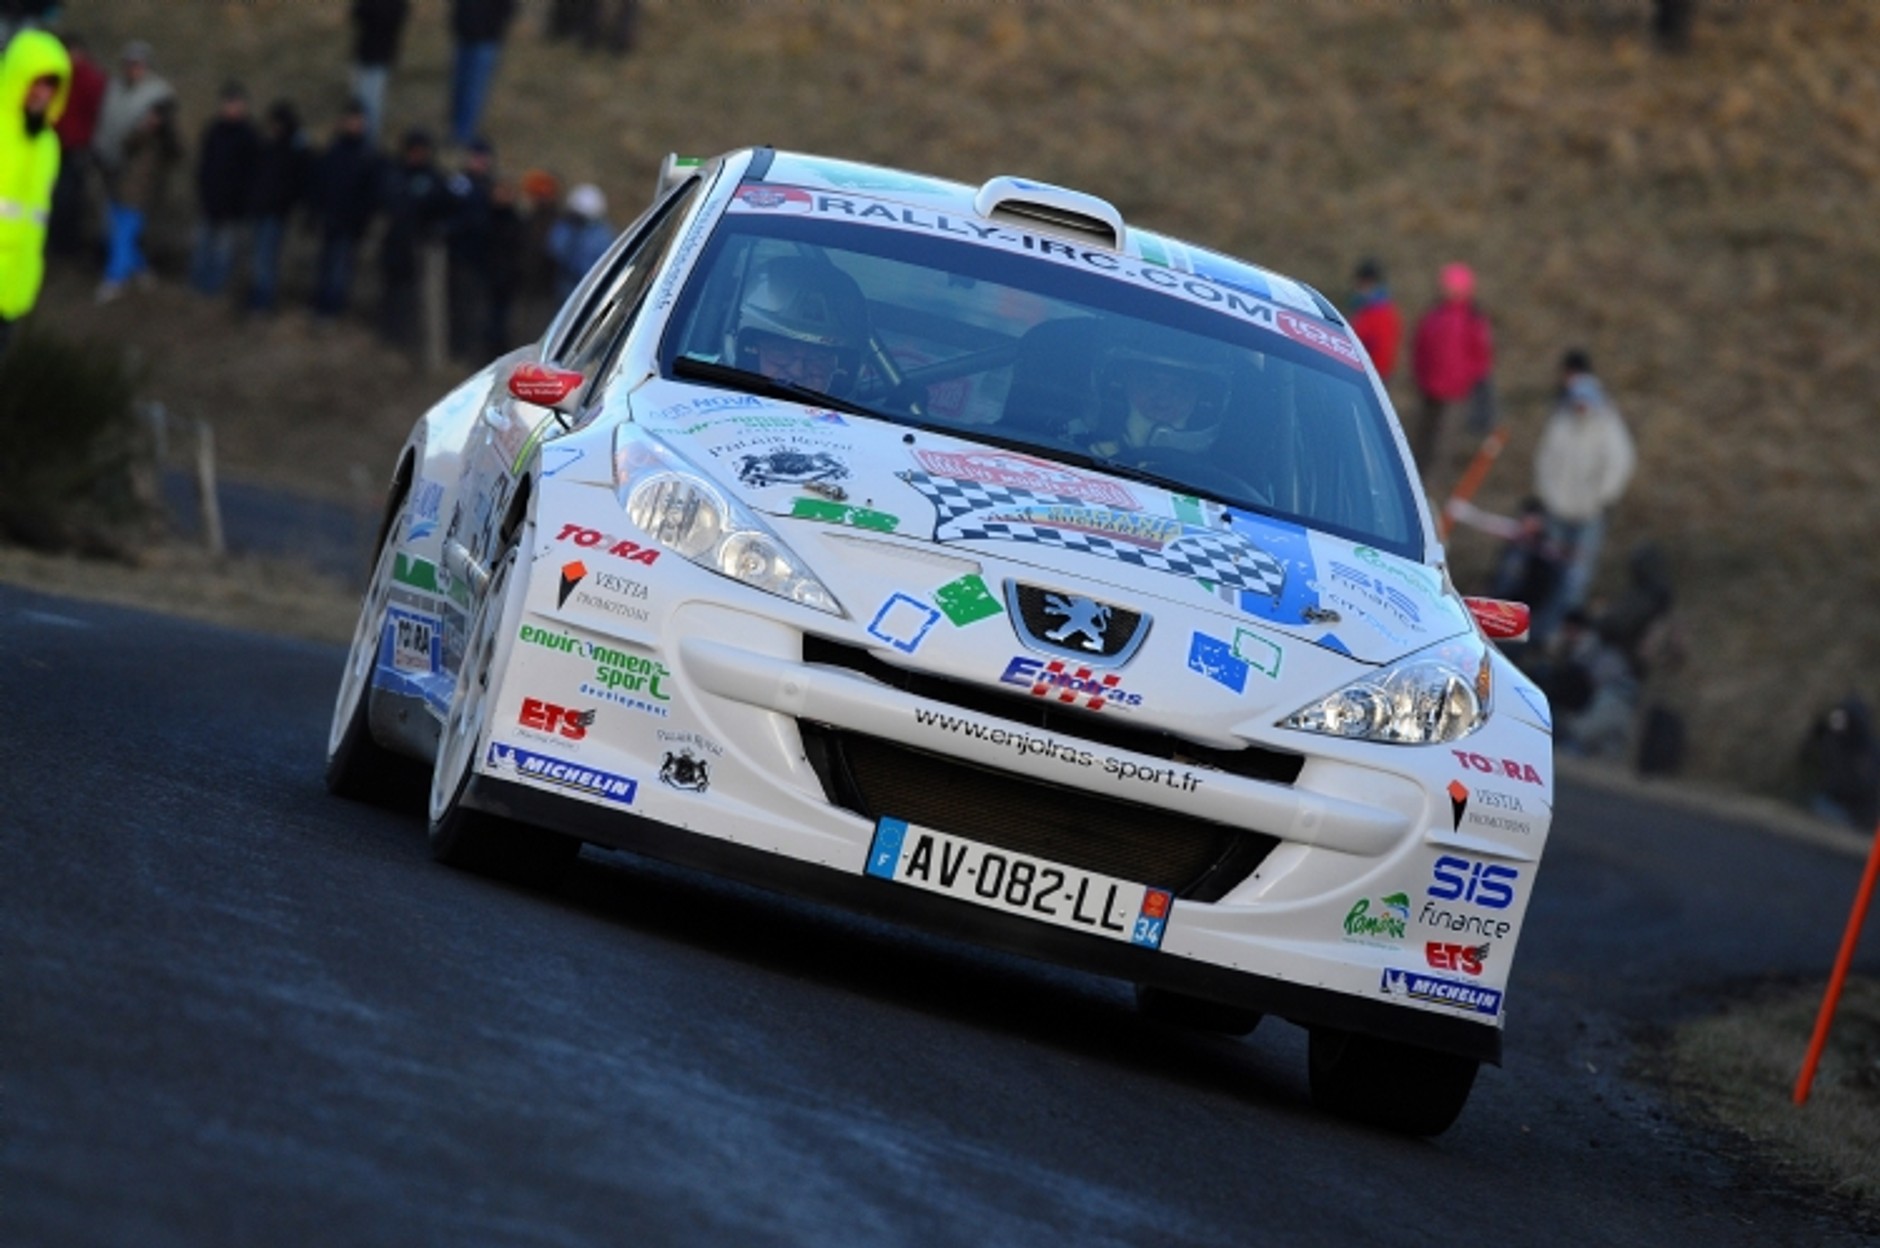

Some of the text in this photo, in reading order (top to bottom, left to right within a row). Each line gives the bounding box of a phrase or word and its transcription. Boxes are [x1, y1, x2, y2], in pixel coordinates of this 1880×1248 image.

[818, 195, 1272, 323] RALLY-IRC.COM
[595, 571, 650, 600] VESTIA
[518, 697, 588, 741] ETS
[579, 683, 668, 718] development
[914, 707, 1204, 793] www.enjolras-sport.fr
[522, 756, 630, 797] MICHELIN
[1474, 787, 1524, 813] VESTIA
[877, 853, 892, 867] F
[905, 834, 1125, 932] AV-082-LL
[1426, 855, 1519, 909] SIS
[1135, 917, 1161, 944] 34
[1418, 901, 1511, 939] finance
[1425, 940, 1484, 976] ETS
[1411, 979, 1497, 1009] MICHELIN
